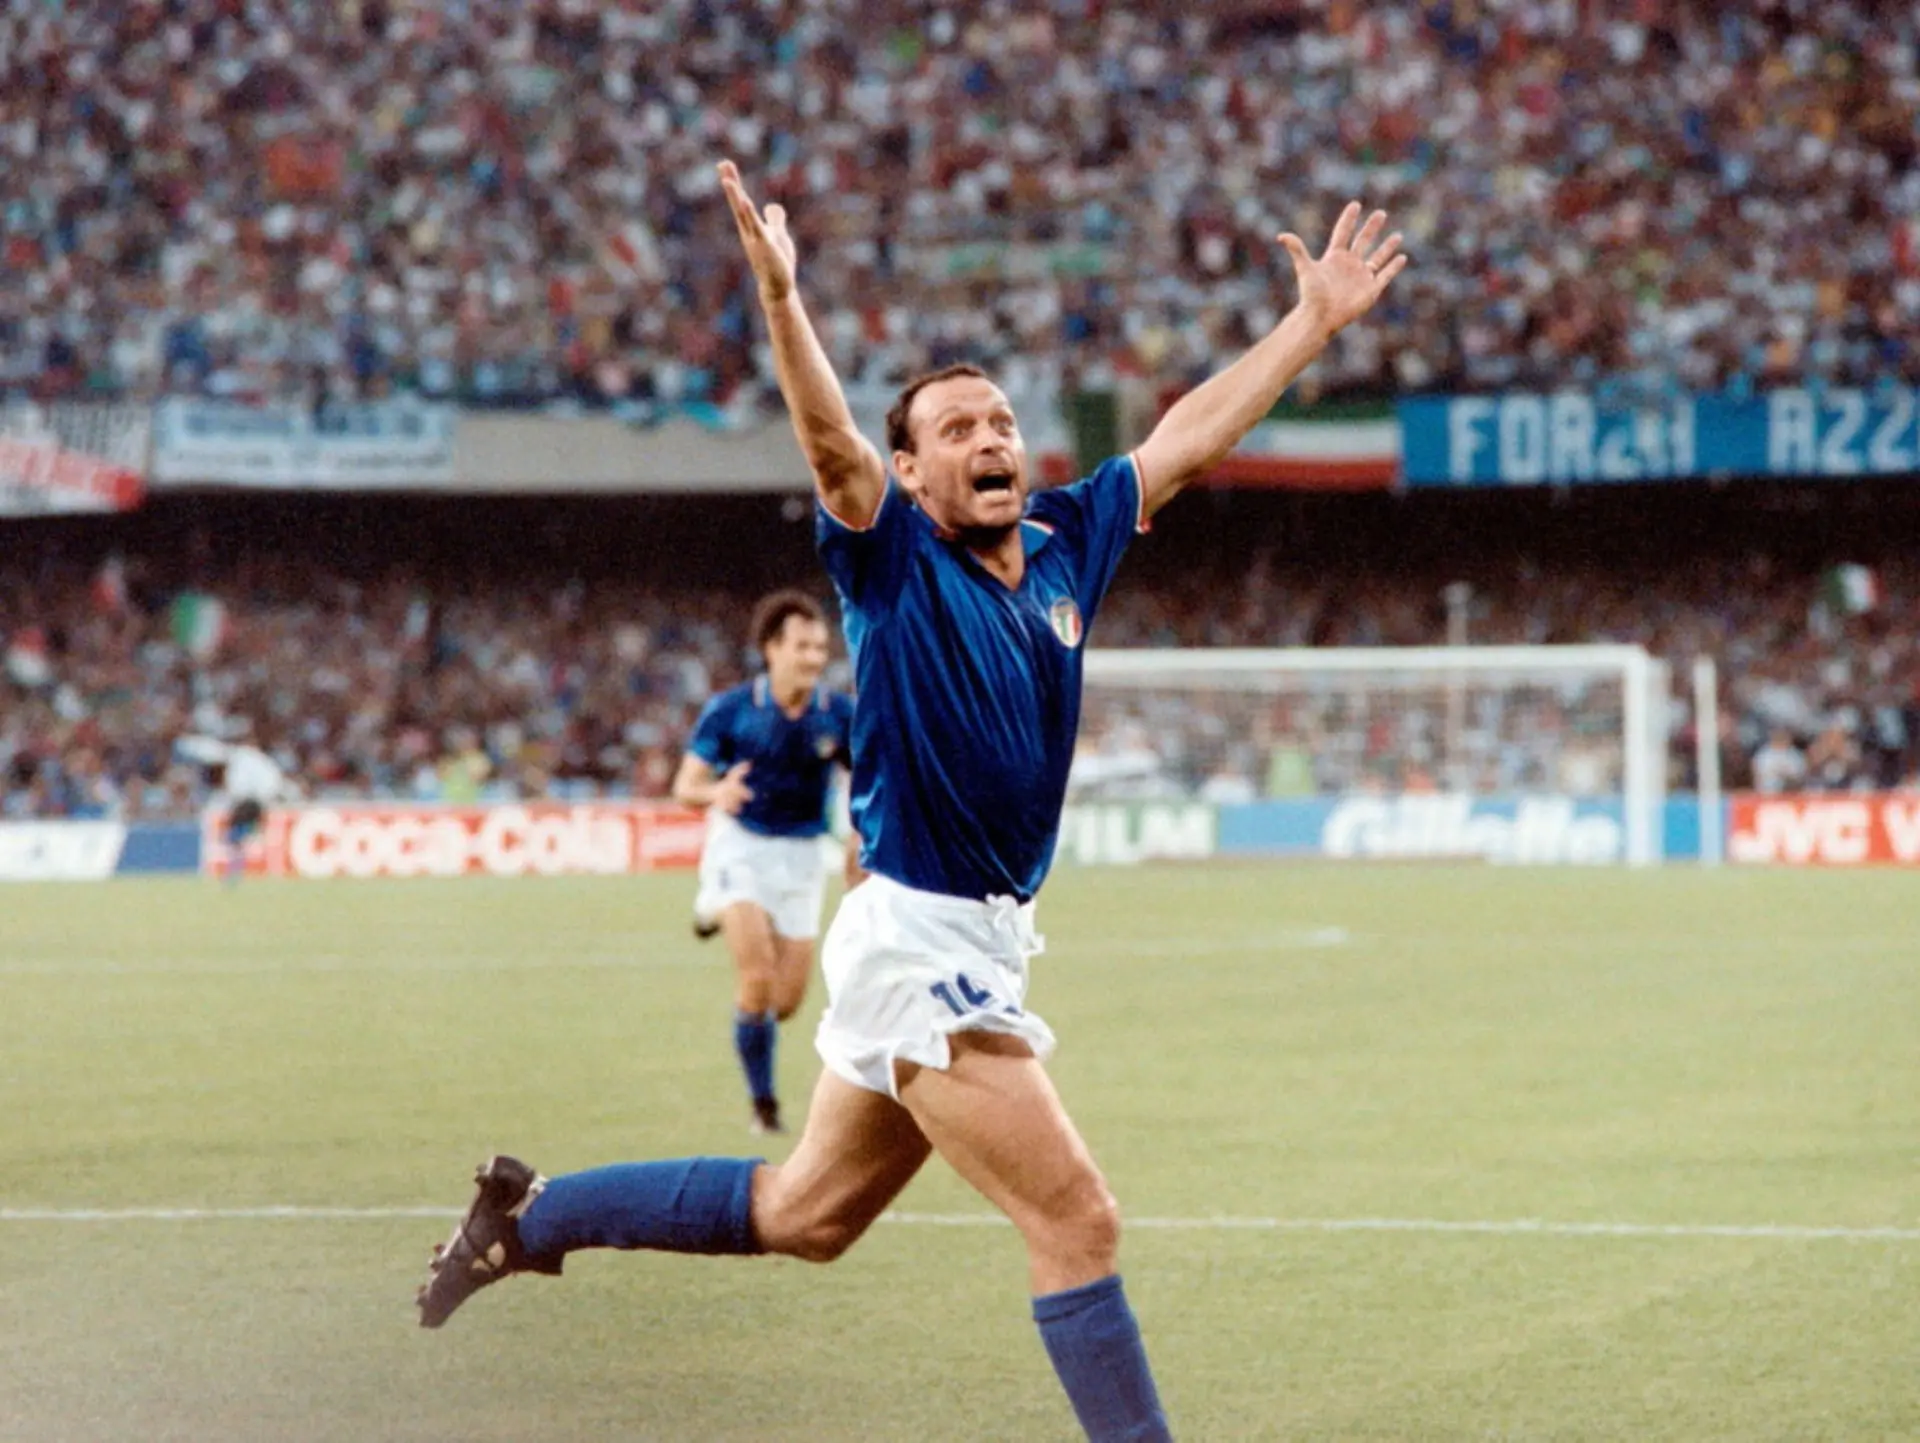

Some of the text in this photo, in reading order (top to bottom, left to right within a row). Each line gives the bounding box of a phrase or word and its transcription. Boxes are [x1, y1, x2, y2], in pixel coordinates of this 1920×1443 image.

[1769, 386, 1920, 474] AZZ
[291, 806, 632, 877] Coca-Cola
[1730, 801, 1871, 863] JVC
